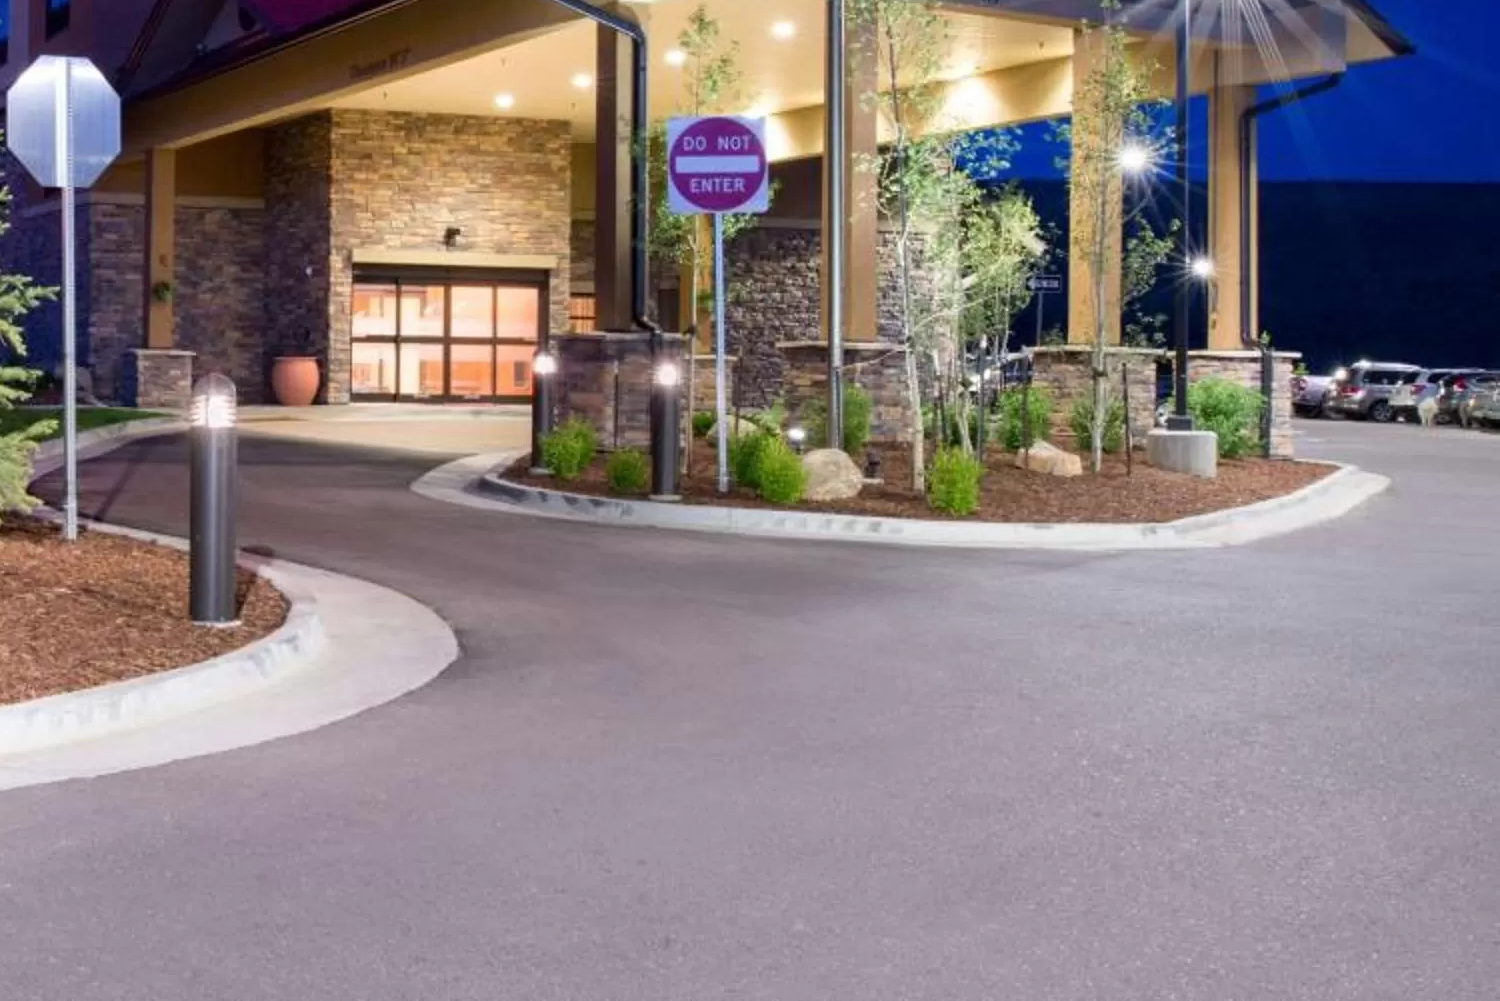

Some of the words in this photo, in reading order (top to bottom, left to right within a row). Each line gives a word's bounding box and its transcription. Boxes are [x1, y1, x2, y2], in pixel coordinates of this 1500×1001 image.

[682, 136, 707, 152] DO
[717, 135, 751, 151] NOT
[690, 178, 746, 194] ENTER
